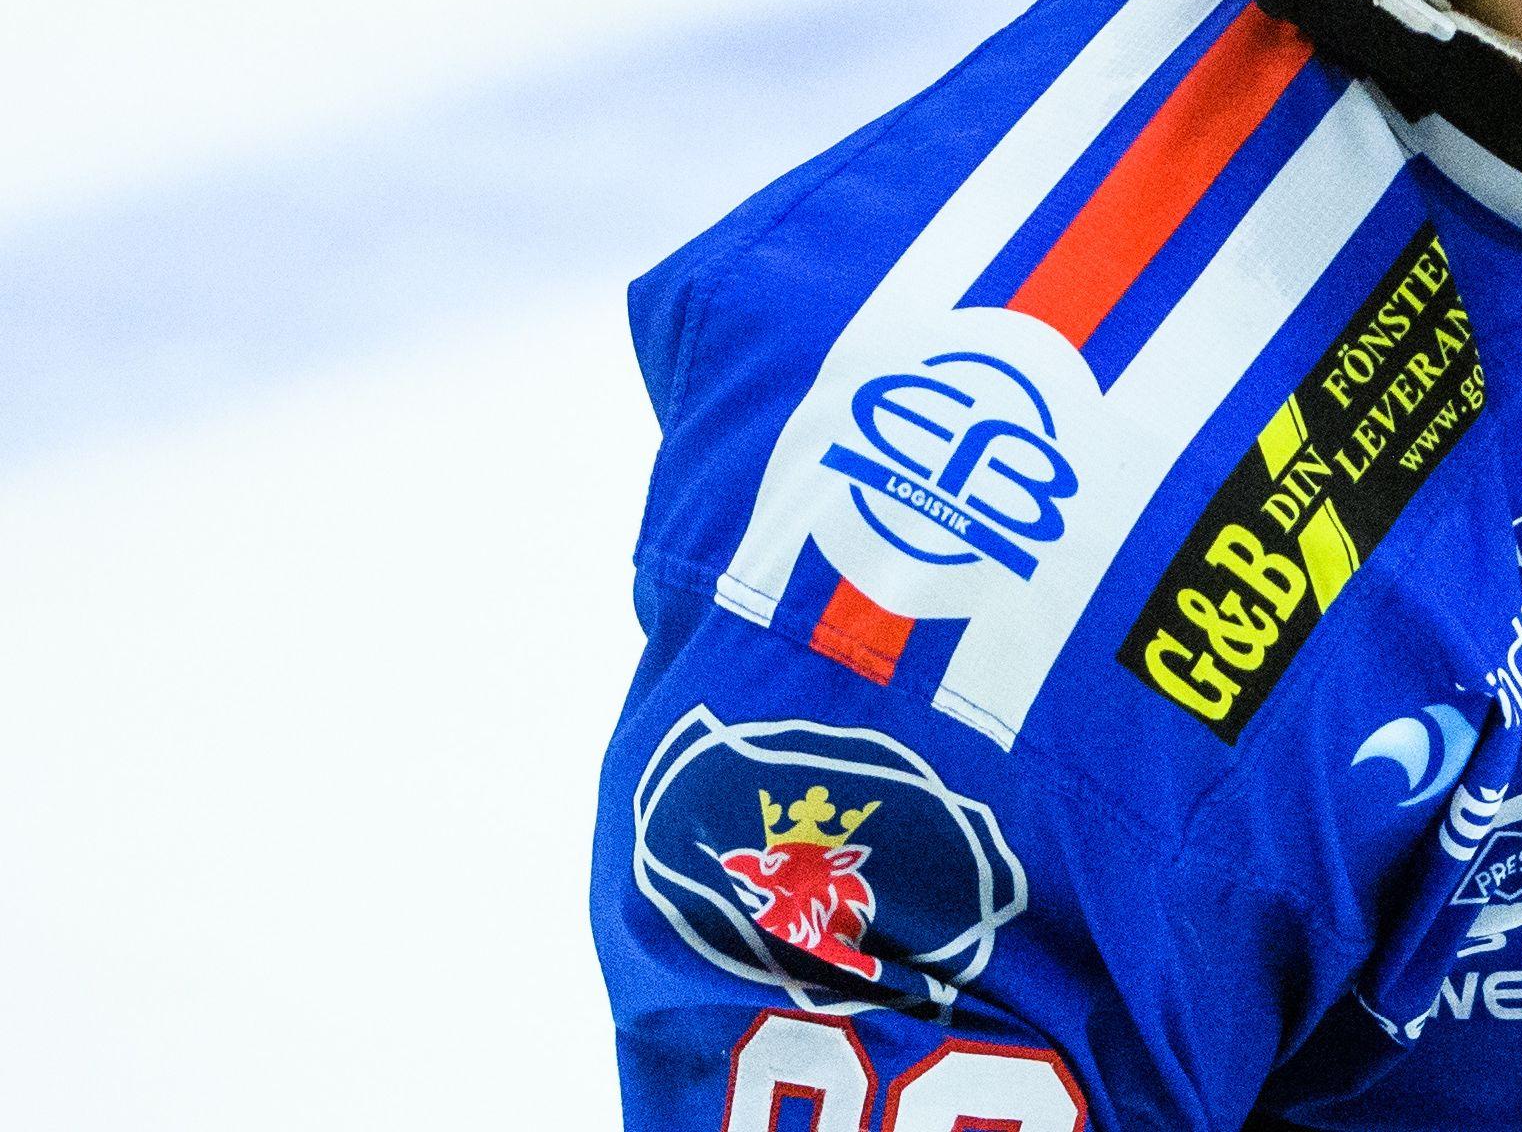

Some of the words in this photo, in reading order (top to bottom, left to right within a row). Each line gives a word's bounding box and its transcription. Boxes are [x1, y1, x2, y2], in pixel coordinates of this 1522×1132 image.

[885, 477, 973, 535] LOGISTIK
[1144, 524, 1307, 721] G&B
[1261, 443, 1333, 534] DIN
